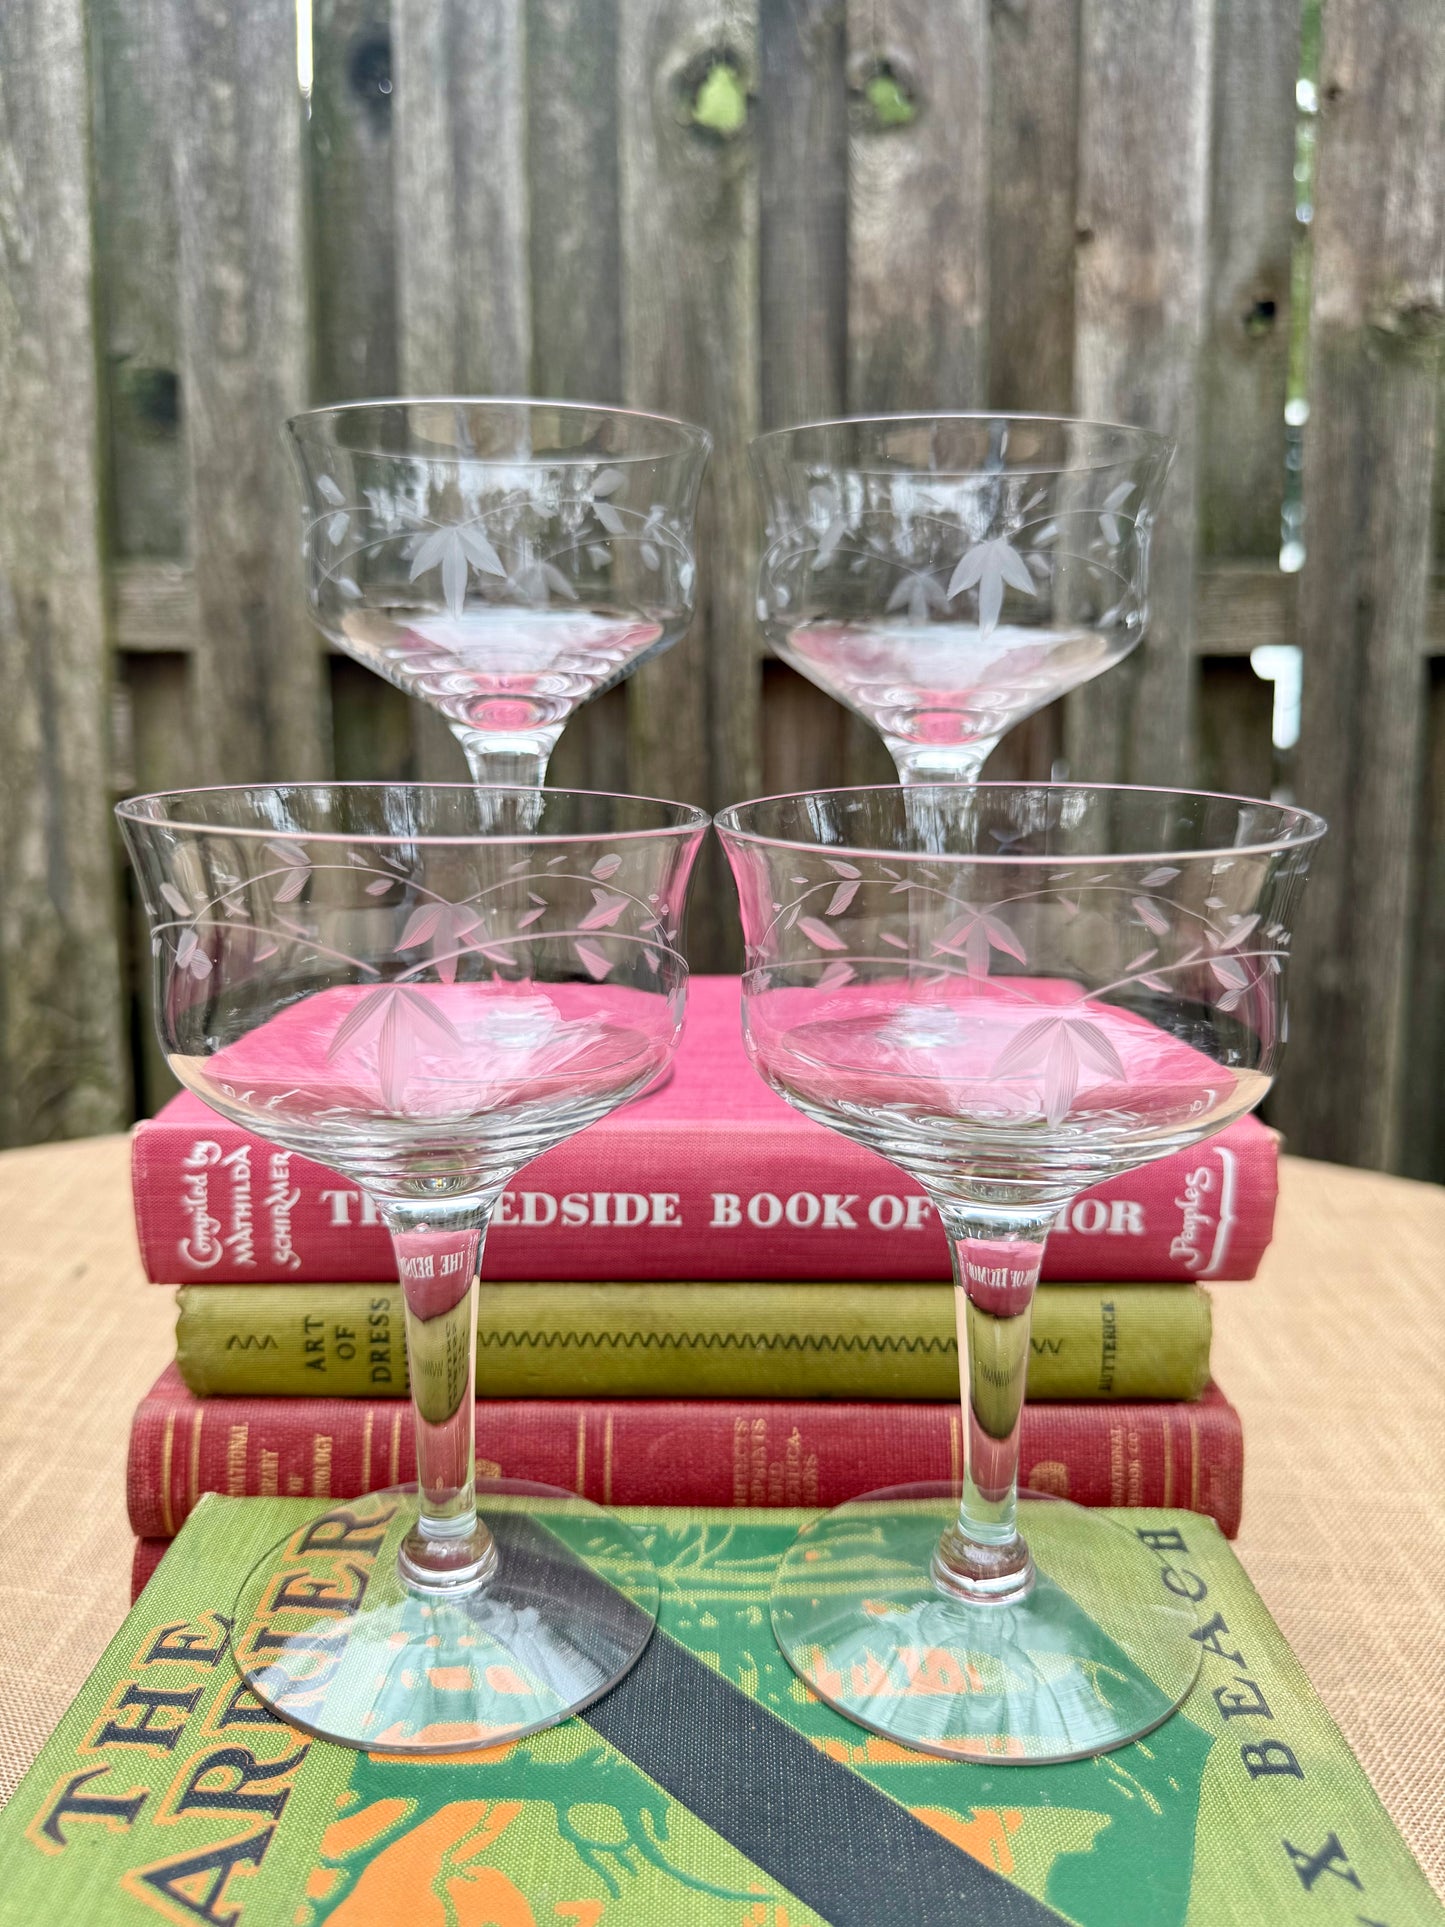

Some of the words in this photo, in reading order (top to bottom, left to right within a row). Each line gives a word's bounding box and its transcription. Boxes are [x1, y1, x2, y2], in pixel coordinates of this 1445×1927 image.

[179, 1140, 224, 1168] by
[179, 1172, 224, 1268] Compiled
[221, 1144, 258, 1265] MATHILDA
[262, 1150, 302, 1270] SCHIRMER
[493, 1191, 683, 1228] EDSIDE
[709, 1191, 859, 1230] BOOK
[868, 1193, 934, 1231] OF
[303, 1314, 326, 1371] ART
[336, 1326, 356, 1361] OF
[369, 1298, 391, 1383] DRESS
[227, 1422, 250, 1496] NATIONAL
[1136, 1527, 1304, 1781] BEACH
[32, 1610, 236, 1853] THE
